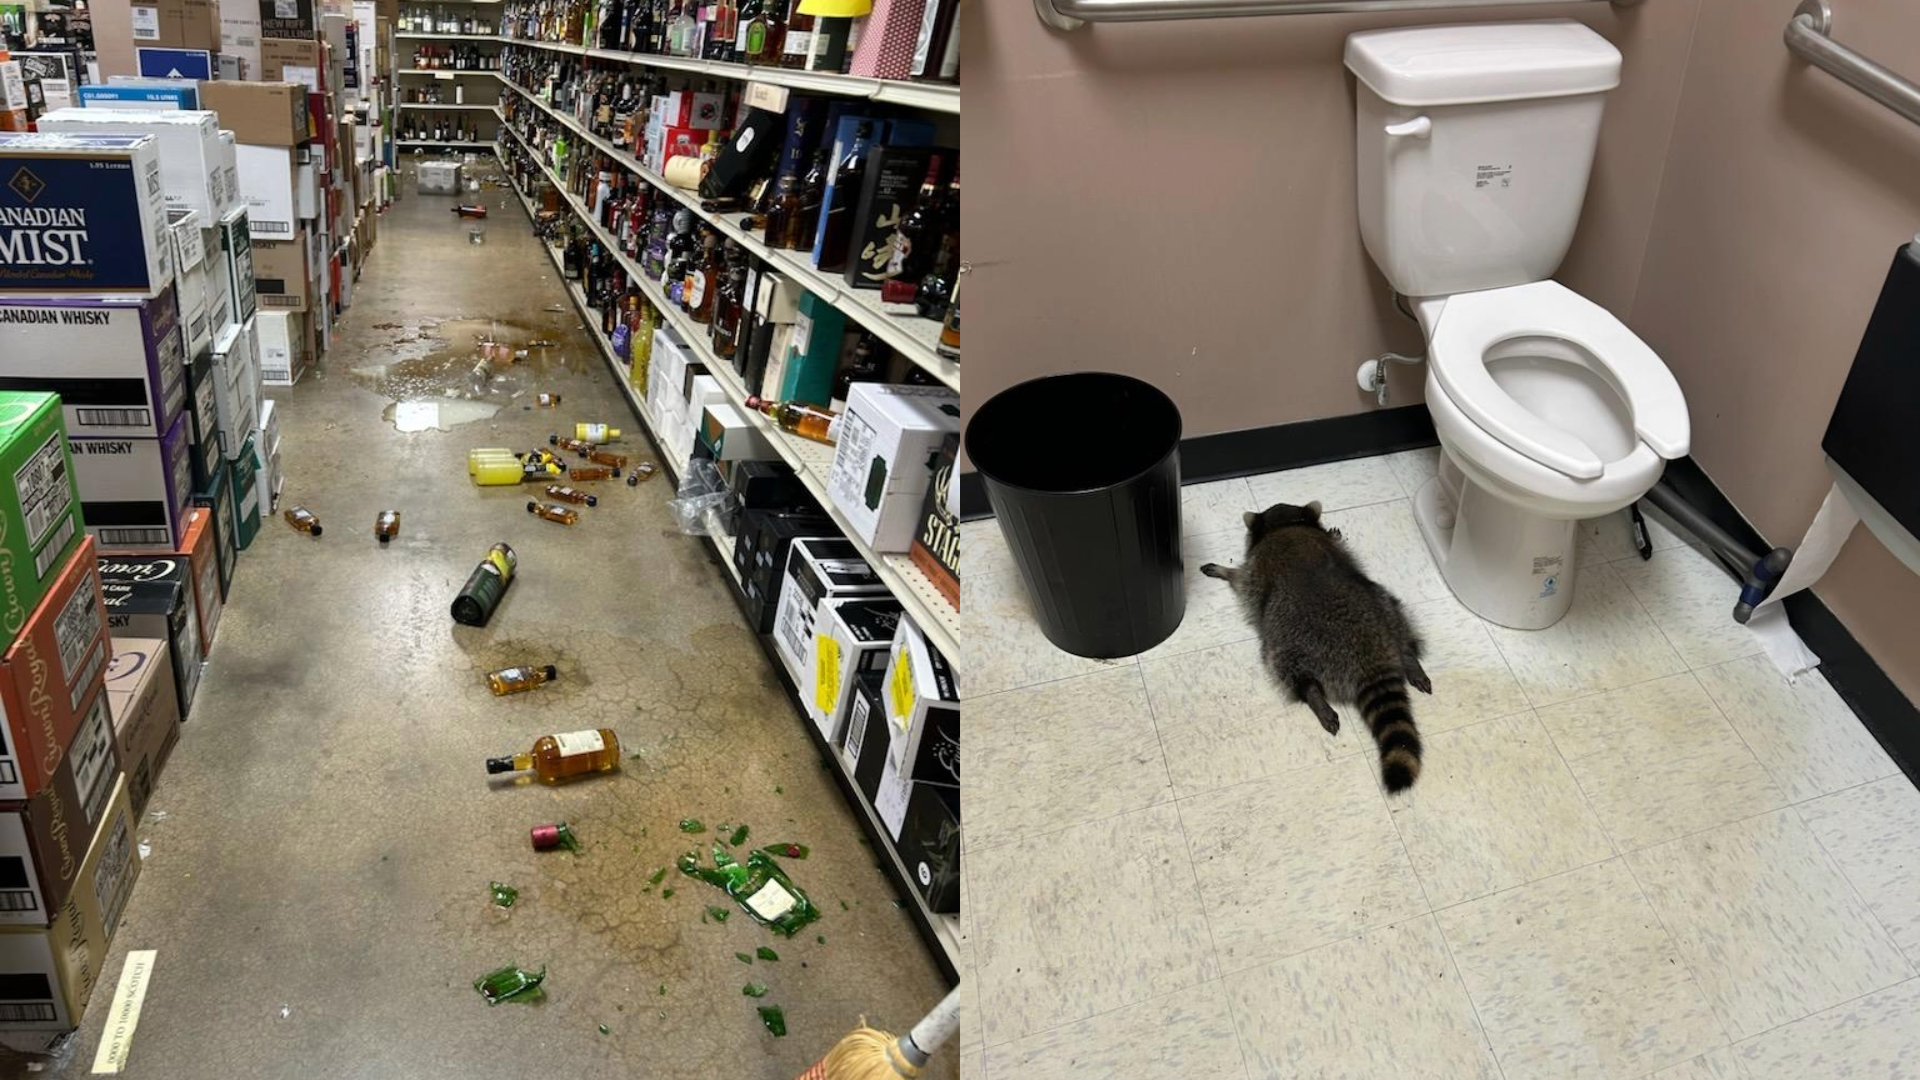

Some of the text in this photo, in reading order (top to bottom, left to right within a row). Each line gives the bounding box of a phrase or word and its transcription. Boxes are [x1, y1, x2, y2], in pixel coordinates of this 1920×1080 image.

[60, 310, 110, 325] WHISKY
[85, 442, 132, 454] WHISKY
[114, 1025, 125, 1039] TO
